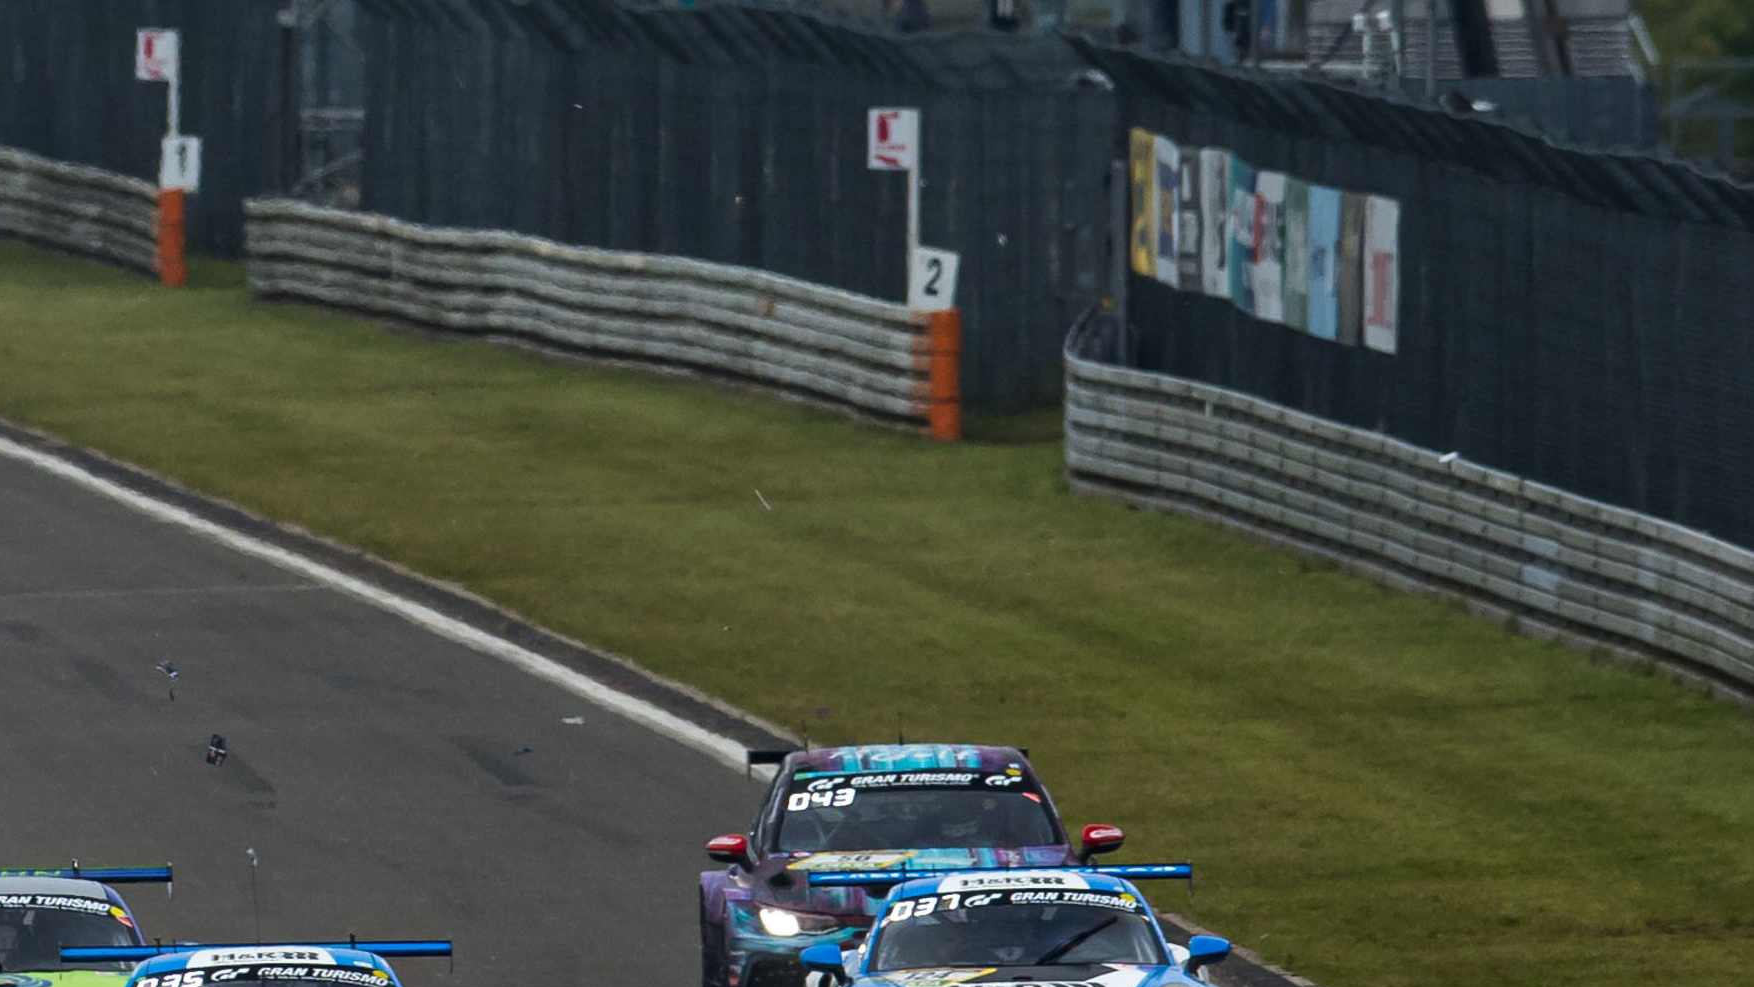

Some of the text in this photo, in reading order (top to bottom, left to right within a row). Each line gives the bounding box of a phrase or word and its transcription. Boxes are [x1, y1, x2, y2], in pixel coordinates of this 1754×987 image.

[924, 257, 943, 297] 2
[850, 774, 895, 785] GRAN
[899, 772, 973, 784] TURISMO
[787, 786, 856, 813] 043
[34, 895, 110, 912] TURISMO
[889, 892, 962, 922] 037
[1009, 890, 1062, 903] GRAN
[1065, 891, 1139, 910] TURISMO
[257, 965, 318, 980] GRAN
[320, 967, 389, 987] TURISMO
